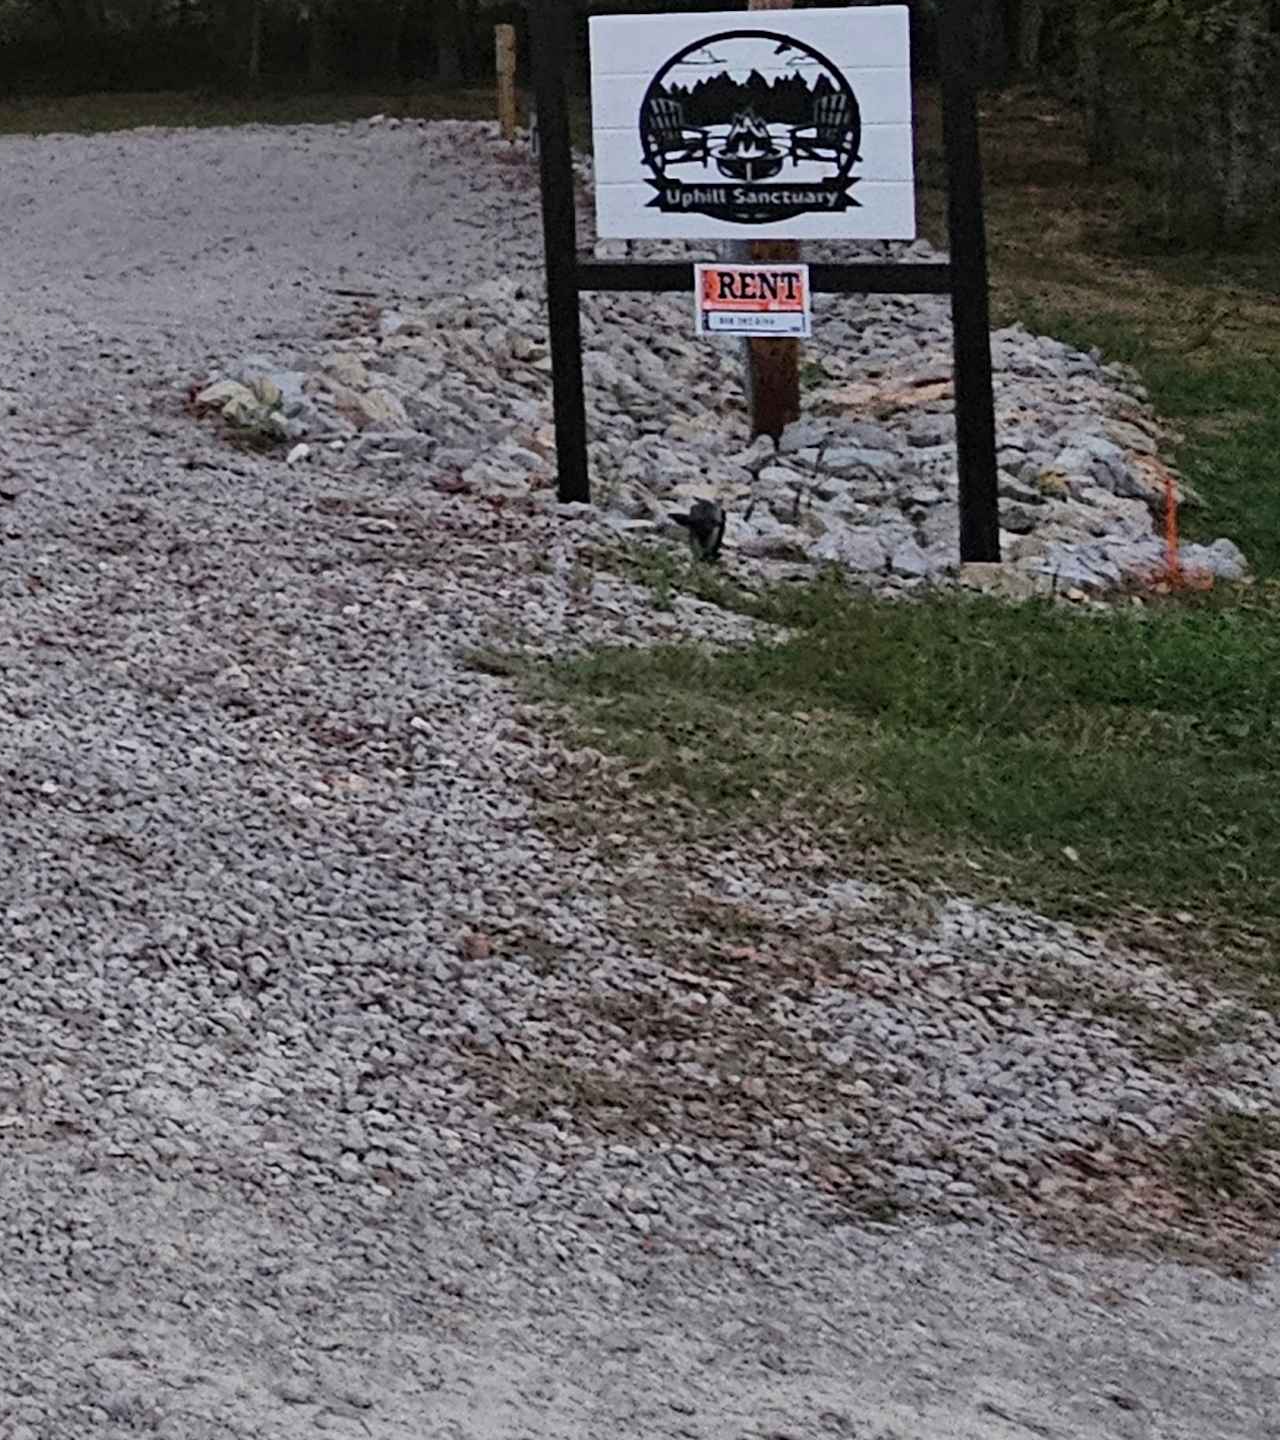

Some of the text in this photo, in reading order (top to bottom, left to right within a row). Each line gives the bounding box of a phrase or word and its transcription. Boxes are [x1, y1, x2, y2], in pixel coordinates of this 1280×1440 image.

[666, 189, 839, 207] Uphill Sanctuary
[717, 271, 800, 300] RENT
